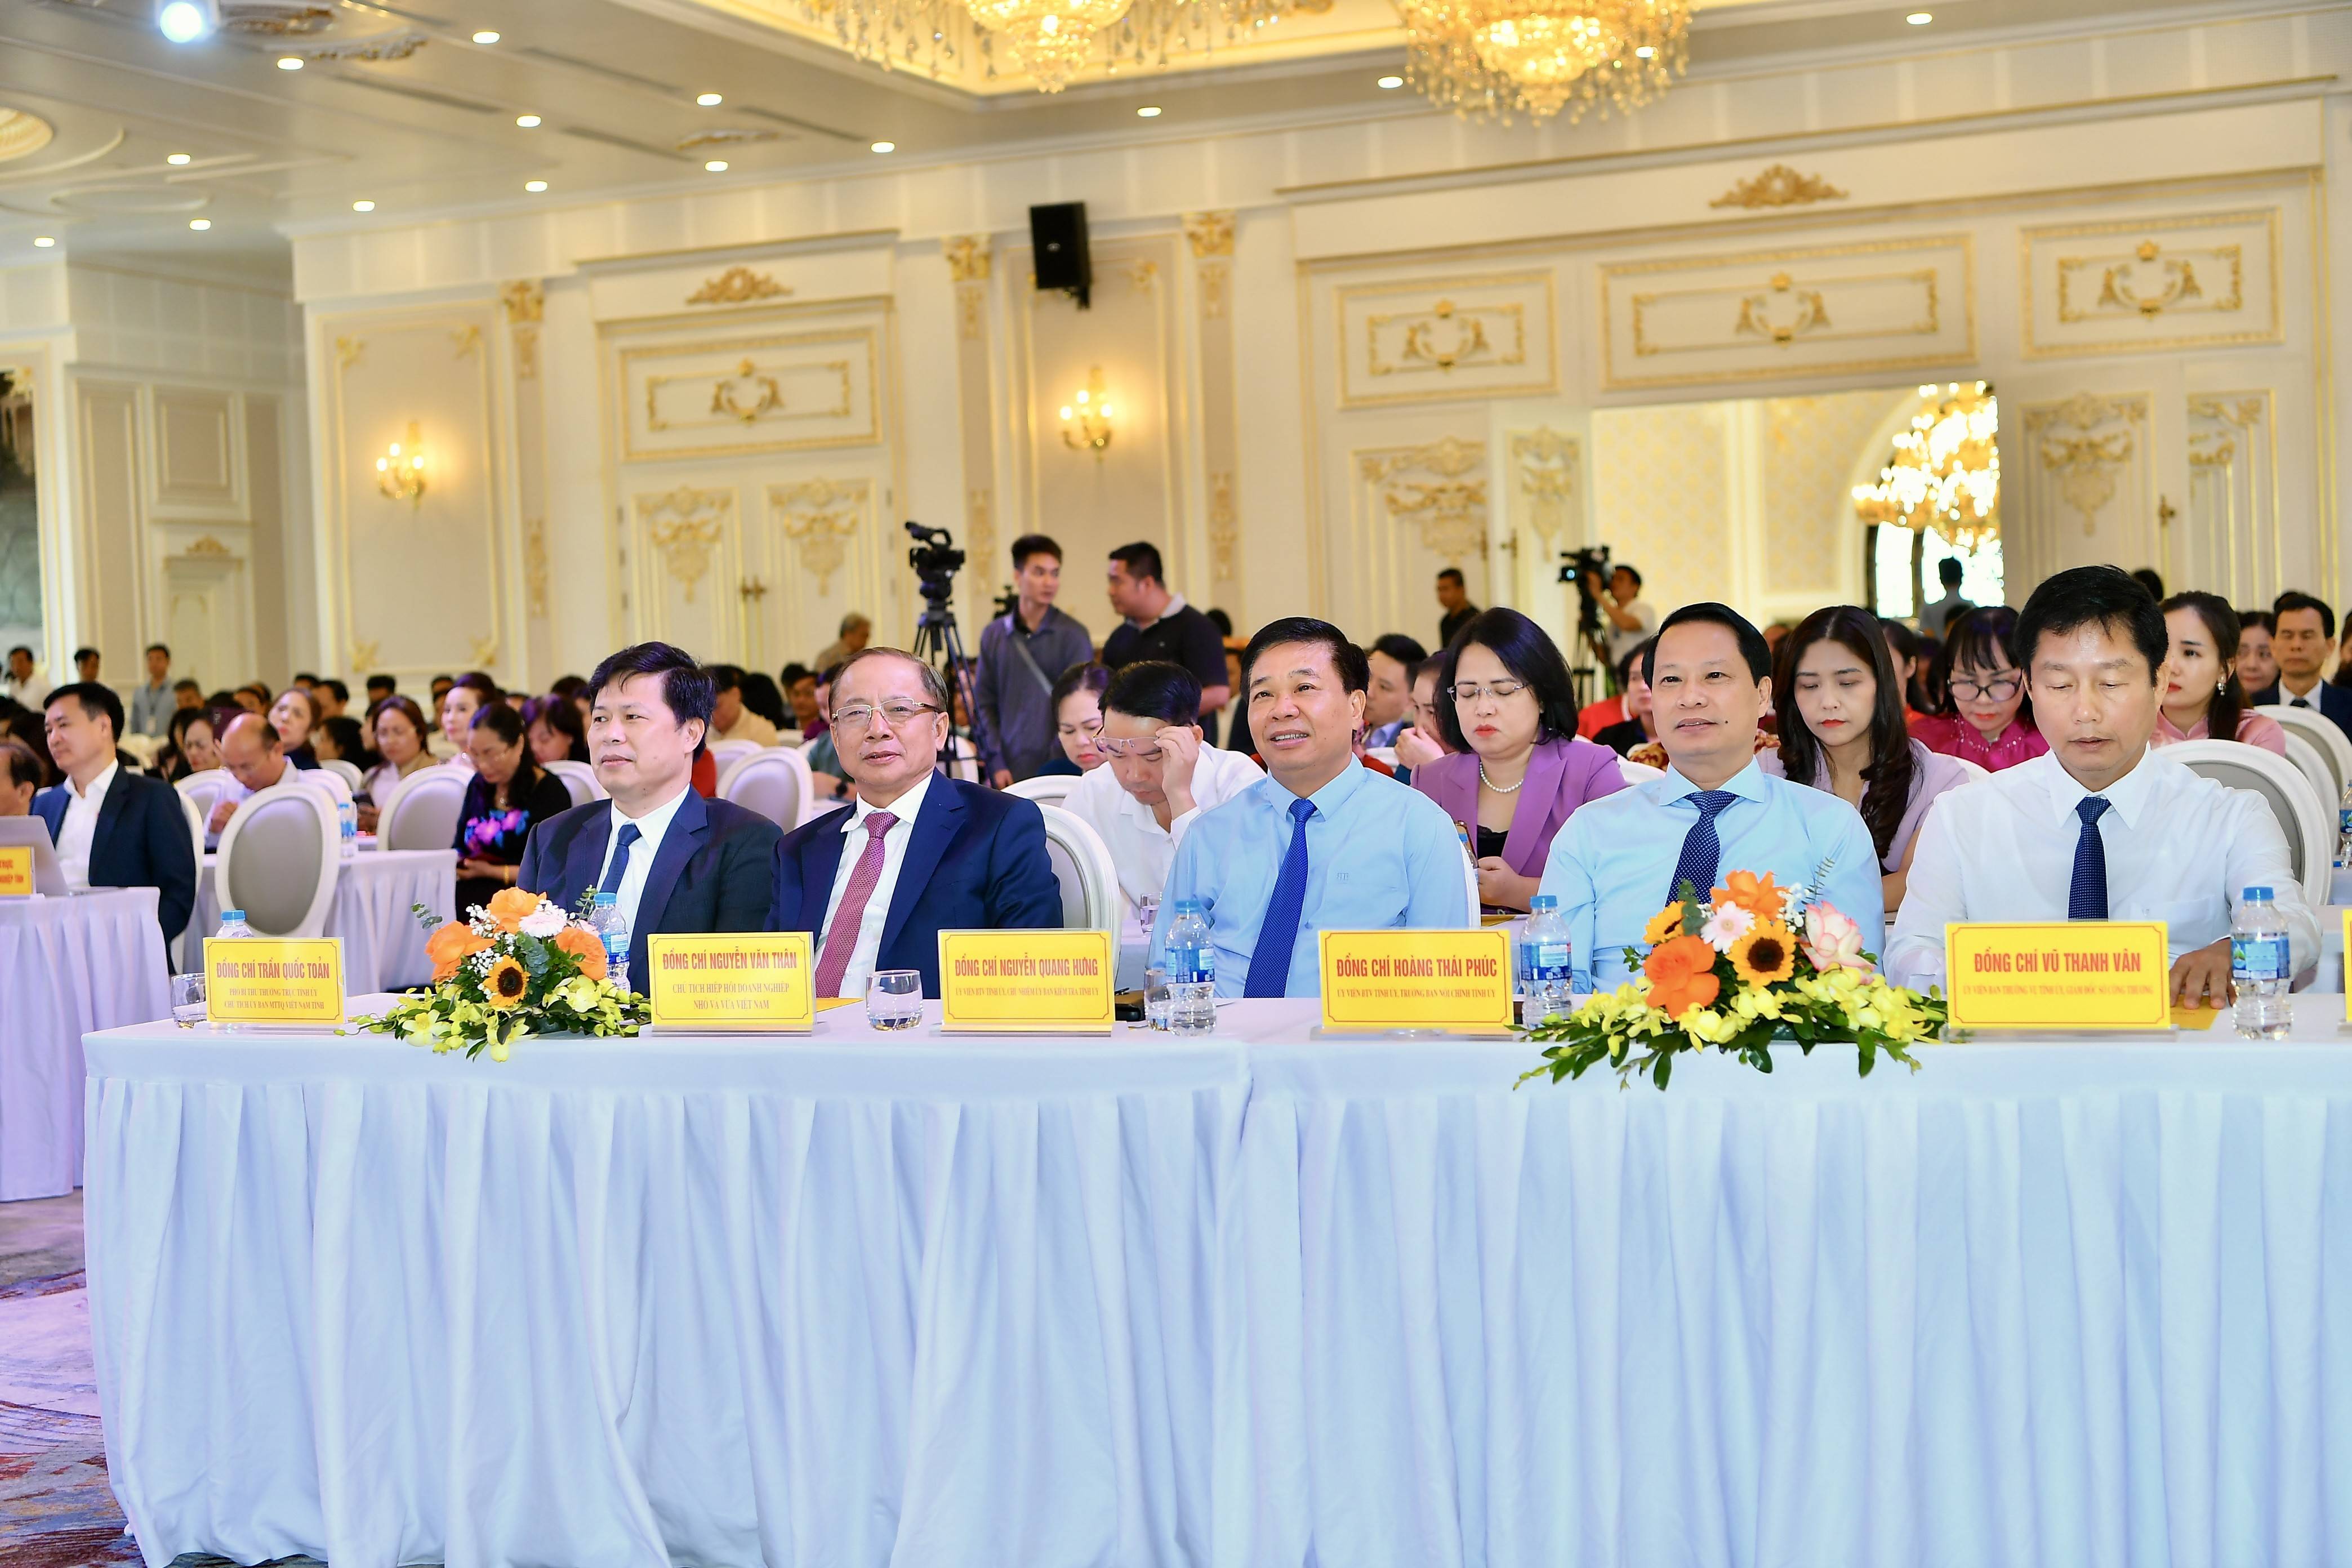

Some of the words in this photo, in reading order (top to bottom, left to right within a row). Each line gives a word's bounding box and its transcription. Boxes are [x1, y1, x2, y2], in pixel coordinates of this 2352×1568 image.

[216, 956, 239, 978] ĐỒNG
[242, 959, 255, 978] CHÍ
[257, 956, 280, 978] TRẦN
[282, 956, 305, 980] QUỐC
[307, 956, 329, 979] TOẢN
[662, 947, 689, 969] ĐỒNG
[691, 949, 707, 969] CHÍ
[710, 946, 747, 969] NGUYỄN
[750, 948, 769, 969] VĂN
[772, 948, 797, 969] THÂN
[955, 954, 979, 976] ĐỒNG
[982, 956, 997, 976] CHÍ
[1000, 952, 1036, 976] NGUYỄN
[1039, 959, 1070, 978] QUANG
[1073, 957, 1098, 976] HƯNG
[1337, 953, 1367, 977] ĐỒNG
[1371, 955, 1389, 977] CHÍ
[1394, 955, 1433, 977] HOÀNG
[1436, 955, 1462, 977] THÁI
[1466, 955, 1497, 977] PHÚC
[1975, 947, 2011, 972] ĐỒNG
[2016, 948, 2037, 972] CHÍ
[2042, 949, 2059, 972] VŨ
[2064, 952, 2109, 972] THANH
[2113, 948, 2141, 972] VÂN
[738, 983, 761, 993] DOANH
[258, 1000, 268, 1009] BAN
[299, 1000, 310, 1009] NAM
[754, 999, 769, 1009] NAM
